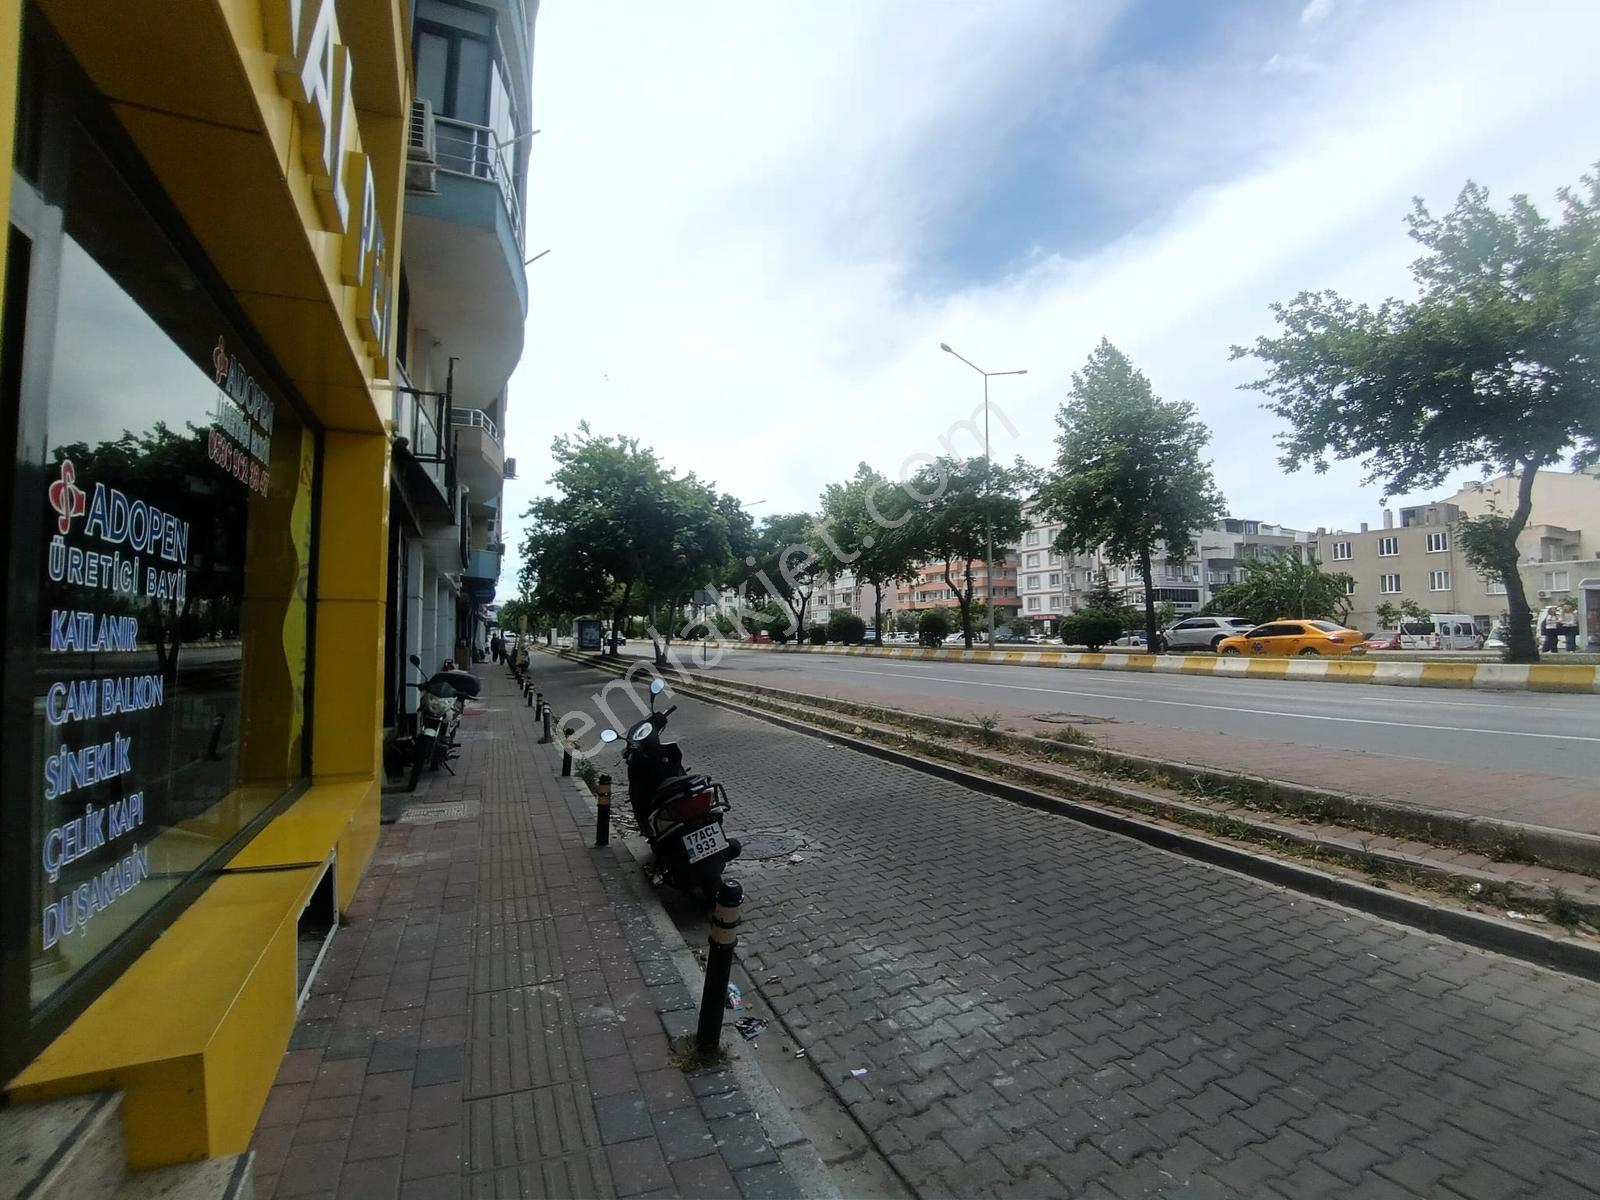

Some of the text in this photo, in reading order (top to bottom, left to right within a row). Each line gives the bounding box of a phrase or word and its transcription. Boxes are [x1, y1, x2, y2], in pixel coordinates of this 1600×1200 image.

[84, 482, 189, 565] ADOPEN
[48, 535, 140, 593] ÜRETİCİ
[51, 610, 138, 653] KATLANIR
[46, 675, 164, 726] CAM BALKON
[44, 735, 132, 801] SİNEKLİK
[43, 792, 144, 884] ÇELİK KAPI
[687, 826, 719, 845] 17ACL
[696, 838, 716, 853] 933
[43, 847, 148, 950] DUŞAKABİN
